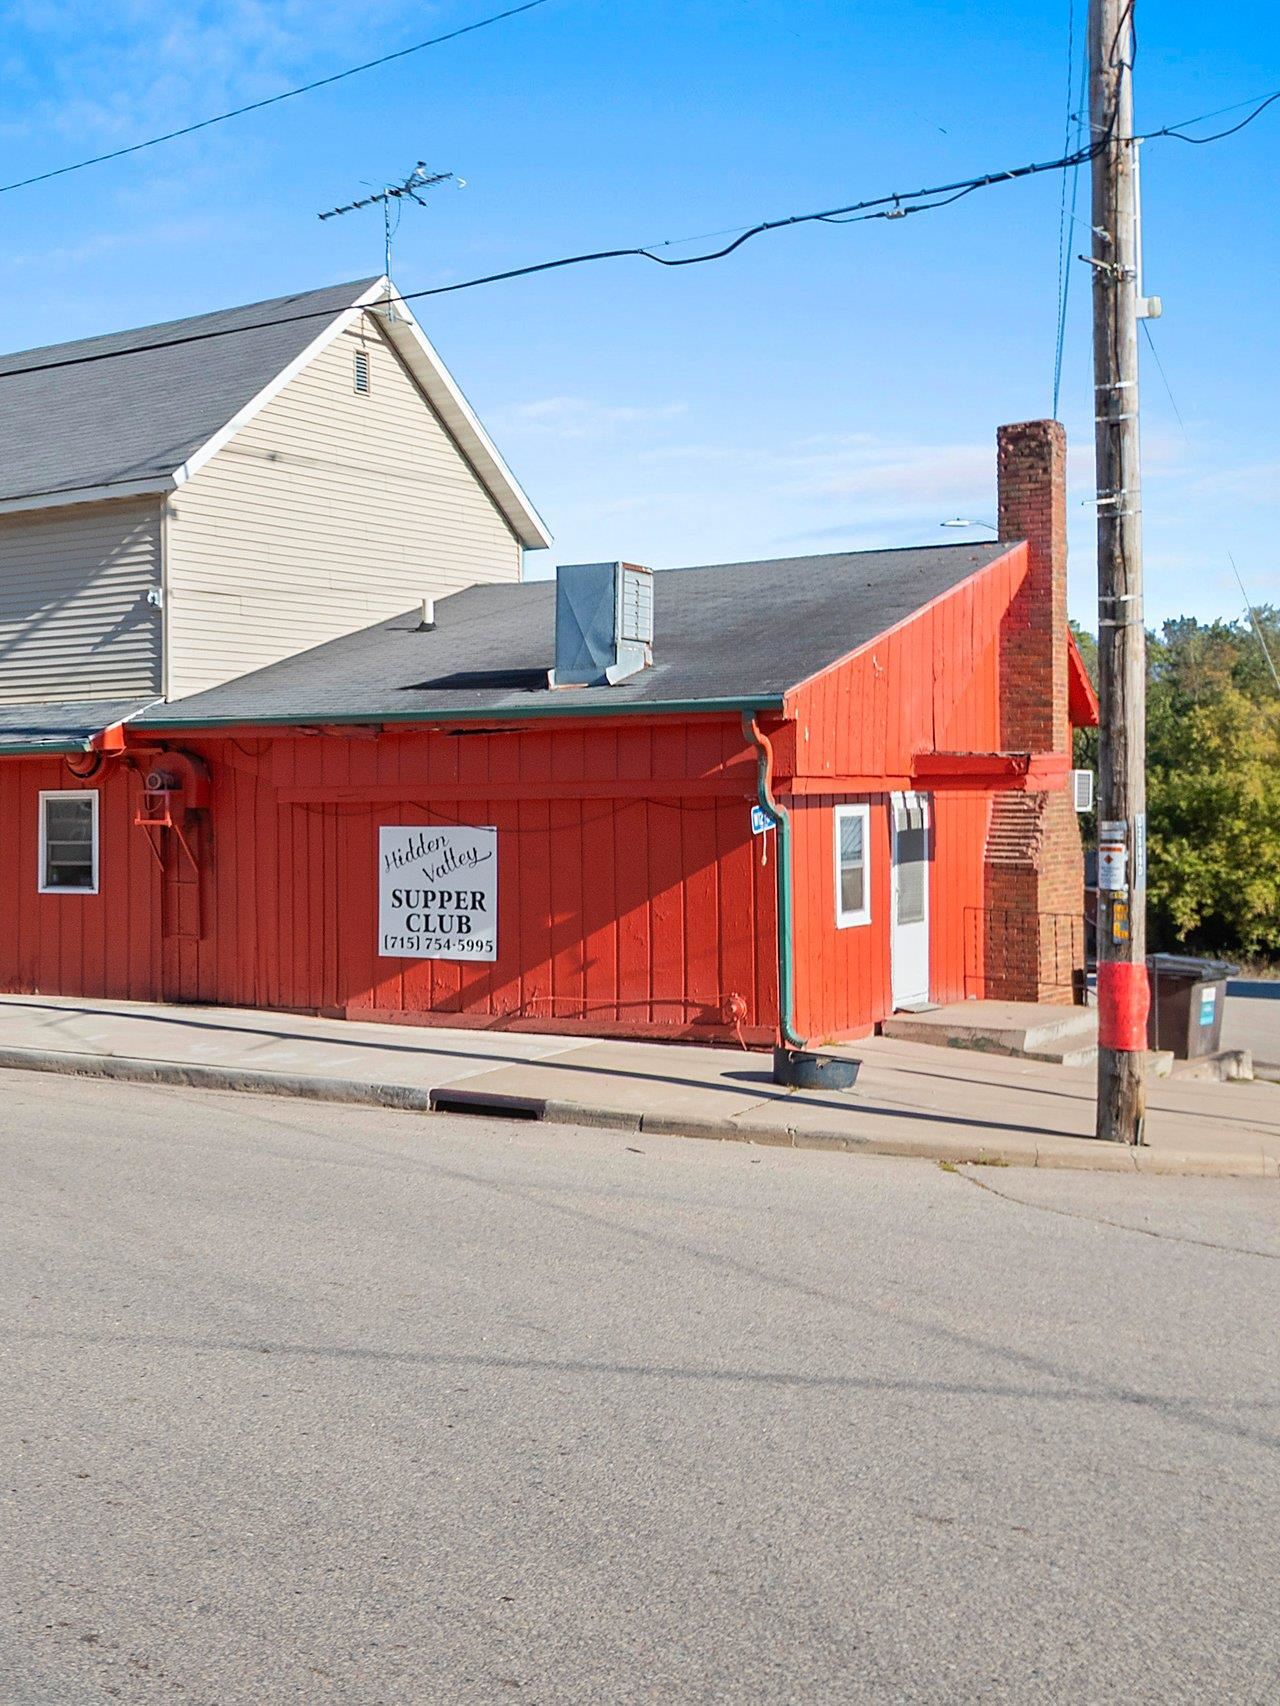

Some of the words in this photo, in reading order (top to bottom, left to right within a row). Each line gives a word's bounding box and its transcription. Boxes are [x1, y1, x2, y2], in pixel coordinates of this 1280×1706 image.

[384, 833, 449, 873] Hidden
[422, 847, 492, 883] Valley
[391, 888, 487, 912] SUPPER
[405, 913, 472, 934] CLUB
[384, 934, 420, 951] (715)
